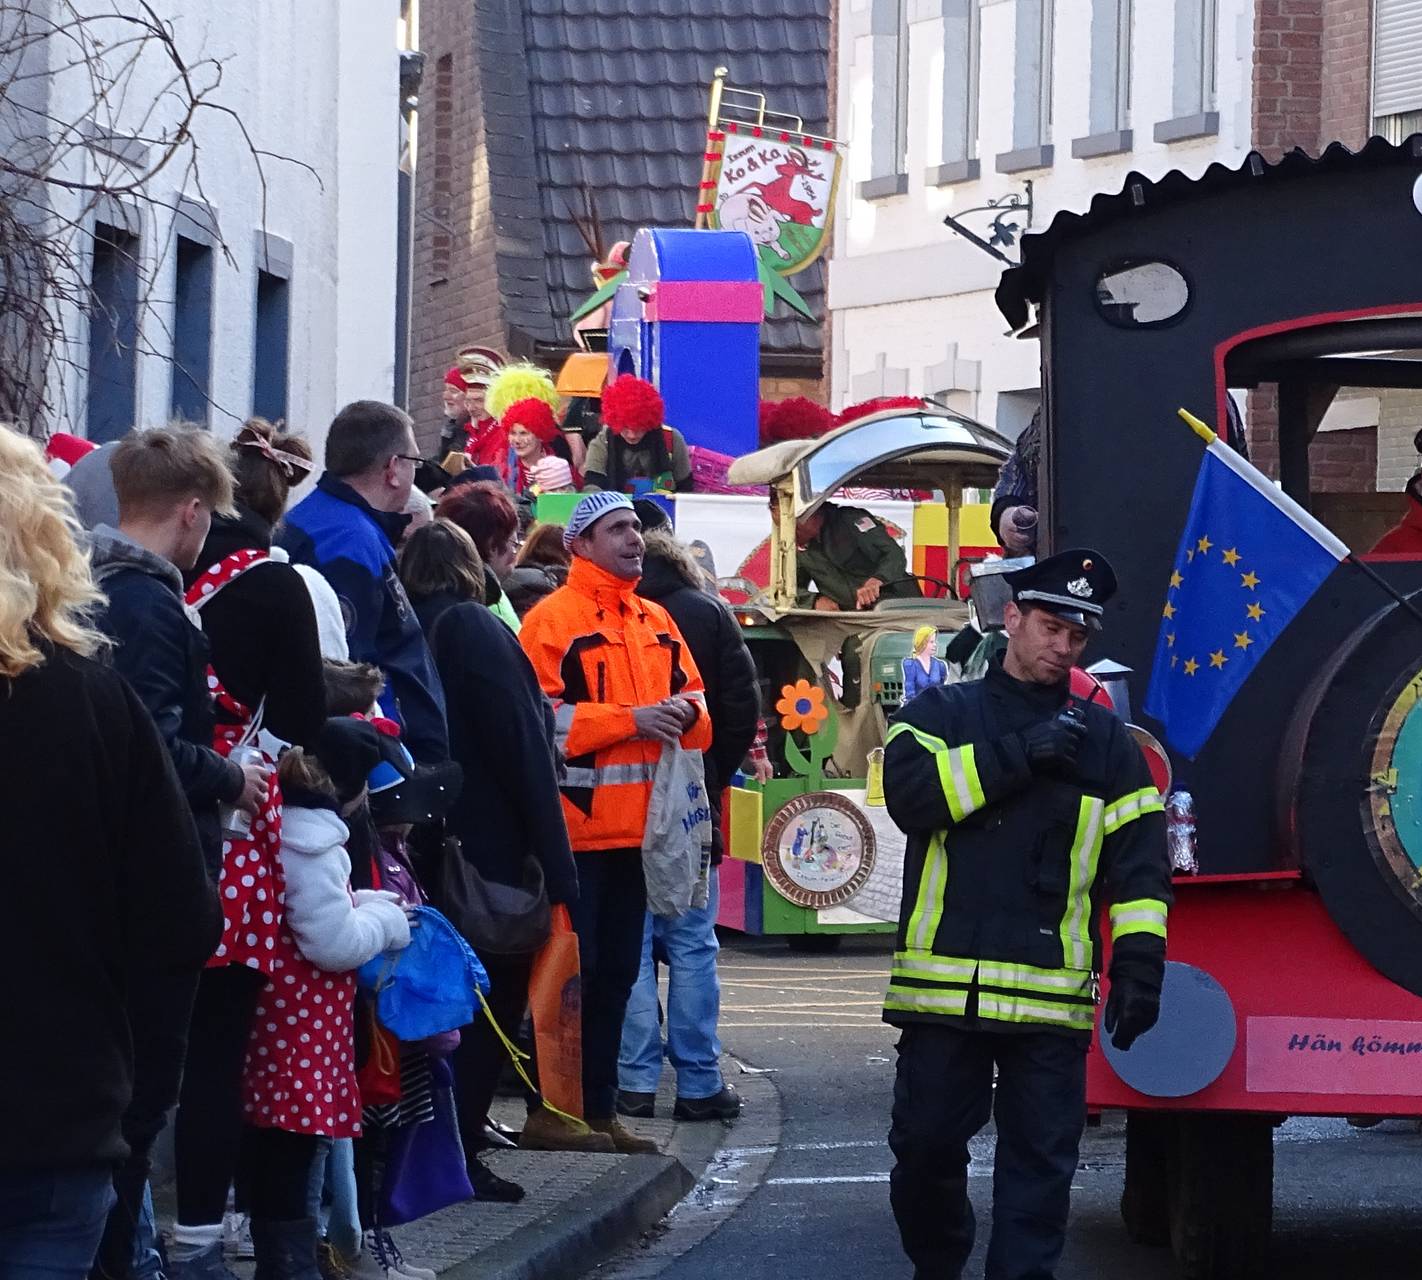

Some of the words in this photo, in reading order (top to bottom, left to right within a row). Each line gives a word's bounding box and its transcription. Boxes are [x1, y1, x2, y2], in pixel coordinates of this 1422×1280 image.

[724, 165, 746, 184] Ko
[747, 157, 761, 172] &
[758, 147, 781, 166] Ka
[1288, 1033, 1342, 1052] Hän
